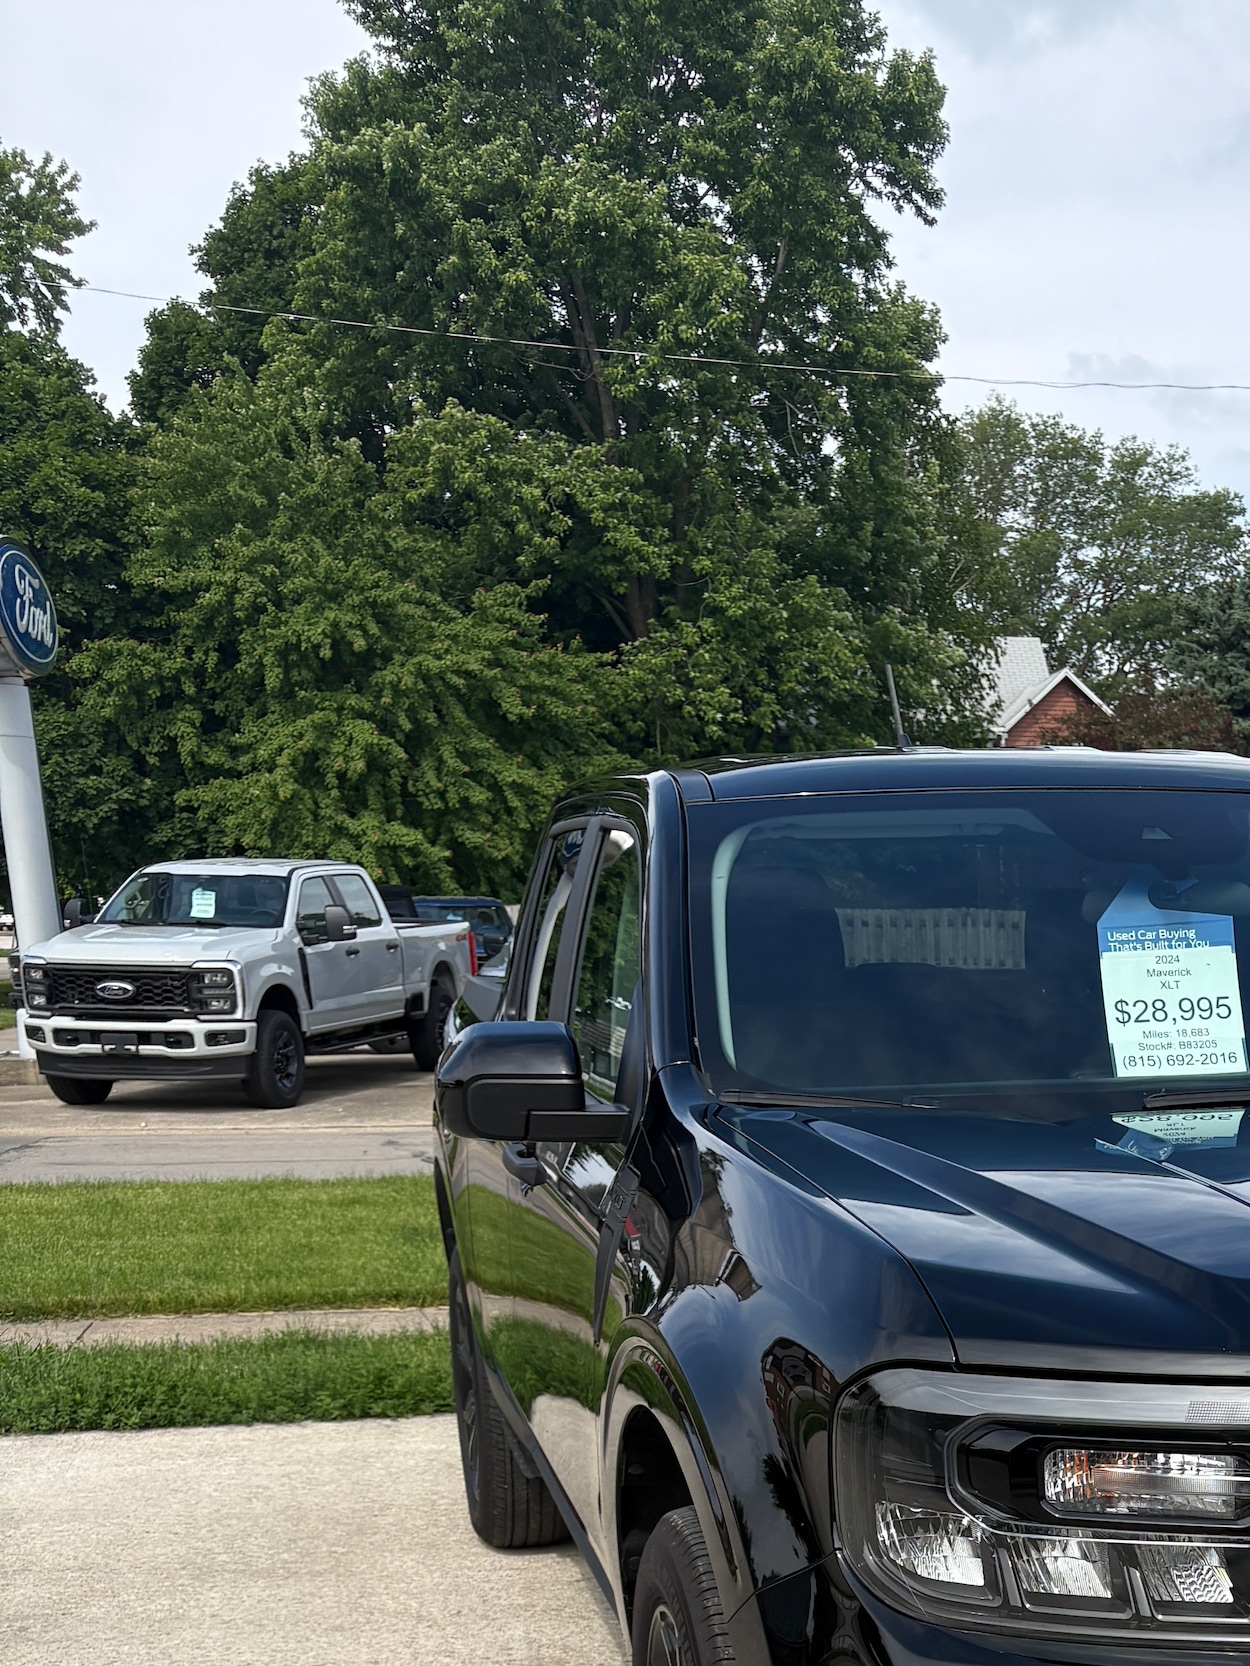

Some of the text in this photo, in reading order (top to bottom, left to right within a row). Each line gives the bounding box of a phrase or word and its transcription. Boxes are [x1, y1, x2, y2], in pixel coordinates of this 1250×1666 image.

[14, 564, 53, 648] Ford
[1107, 928, 1196, 941] Used Car Buying
[1108, 939, 1210, 952] That's Built for You
[1155, 955, 1180, 964] 2024
[1146, 968, 1192, 978] Maverick
[1160, 980, 1181, 990] XLT
[1114, 995, 1232, 1027] $28,995
[1142, 1028, 1210, 1039] Miles: 18,683
[1138, 1040, 1218, 1051] Stock#: B83205
[1122, 1052, 1238, 1070] (815) 692-2016
